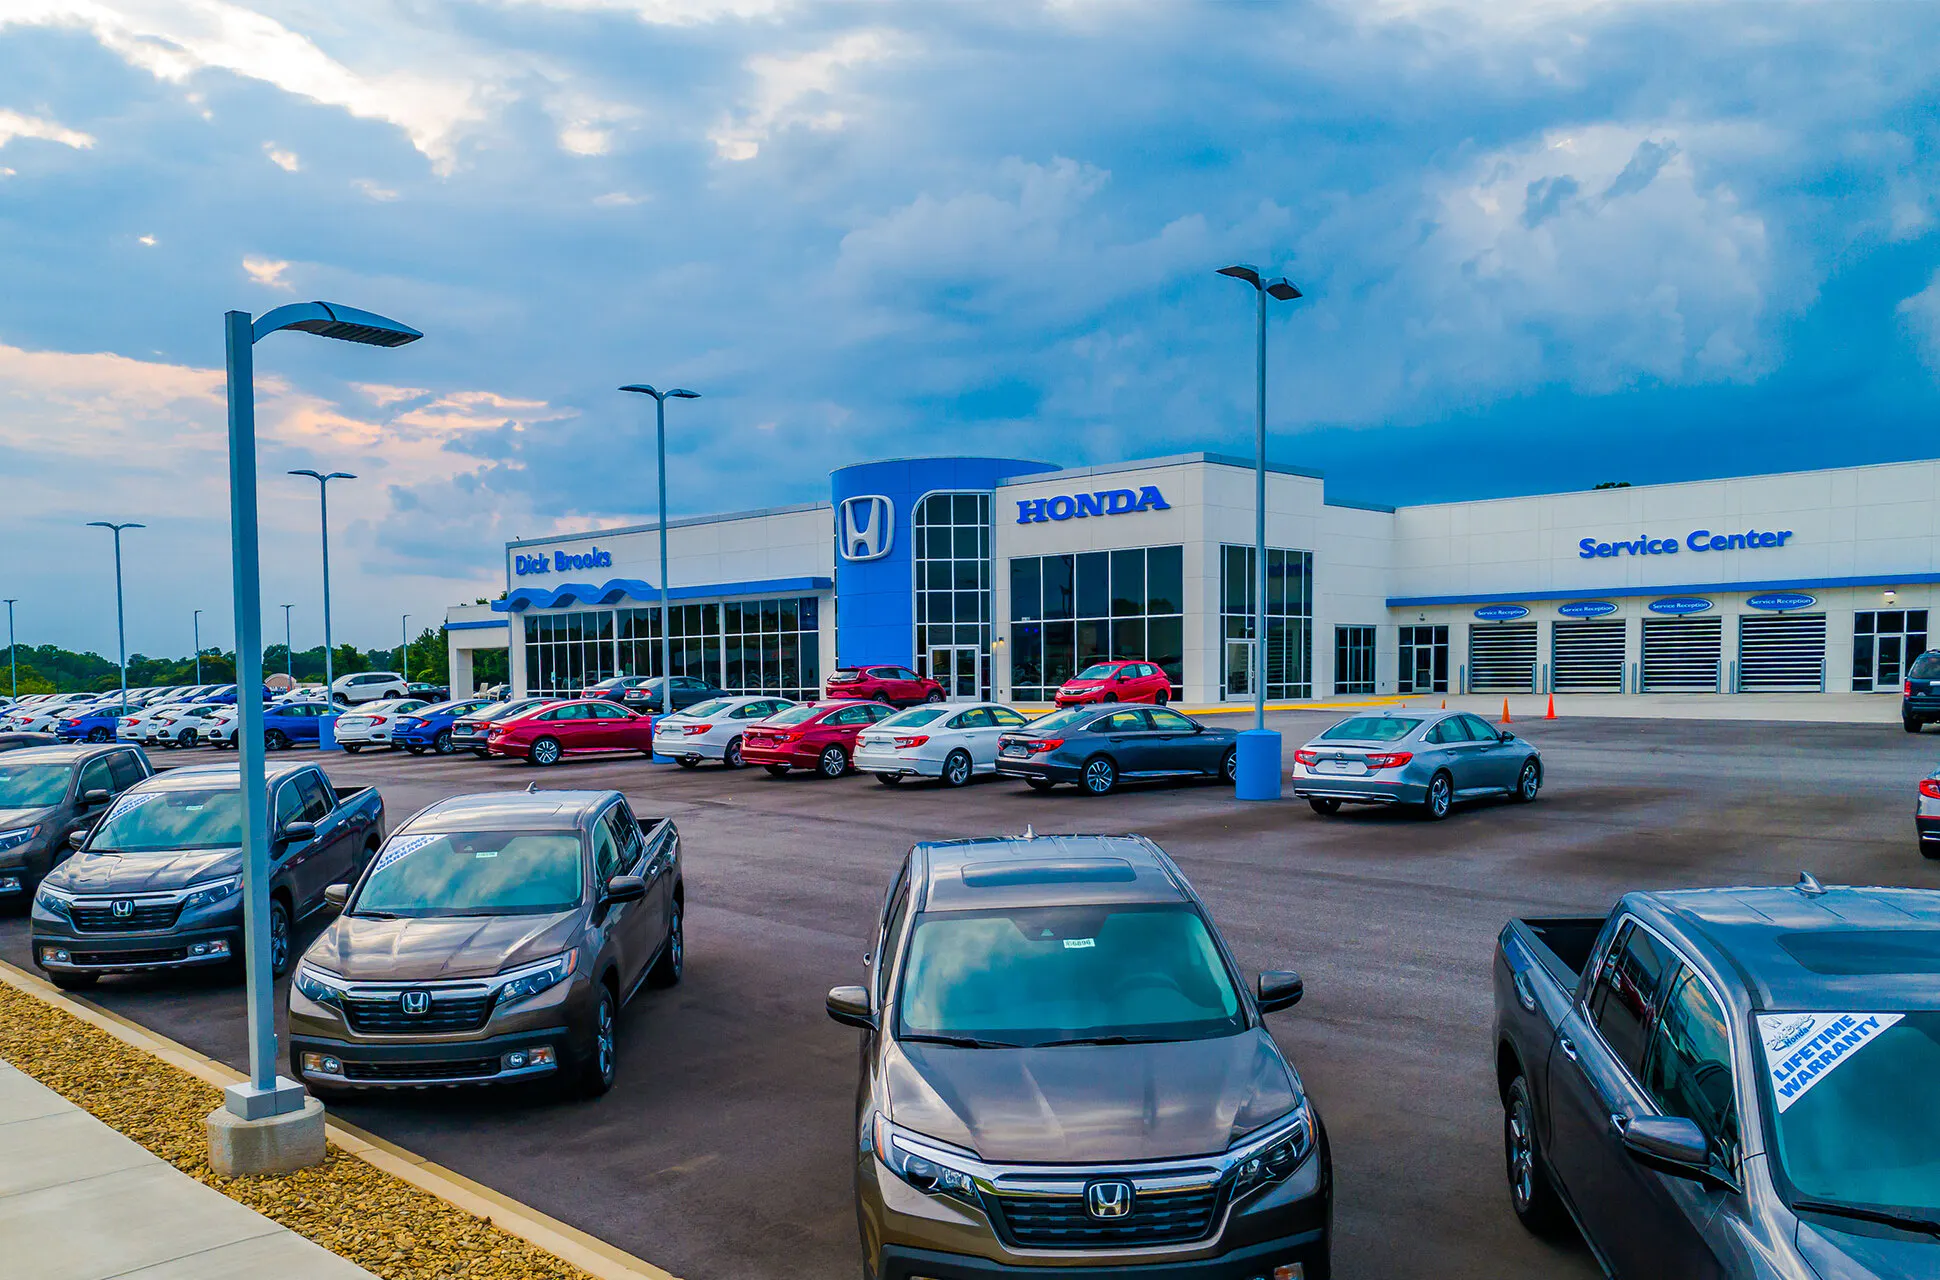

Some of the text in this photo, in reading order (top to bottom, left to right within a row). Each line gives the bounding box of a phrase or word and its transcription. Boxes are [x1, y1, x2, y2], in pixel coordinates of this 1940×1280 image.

[1016, 486, 1171, 525] HONDA
[1579, 529, 1793, 560] Service Center
[515, 546, 613, 576] Dick Brooks
[1497, 608, 1525, 616] Reception
[1583, 604, 1613, 613] Reception
[1751, 596, 1812, 605] Service Reception
[376, 836, 435, 871] WARRANTY
[1773, 1014, 1857, 1082] LIFETIME
[1784, 1027, 1810, 1047] Honda
[1778, 1015, 1881, 1099] WARRANTY
